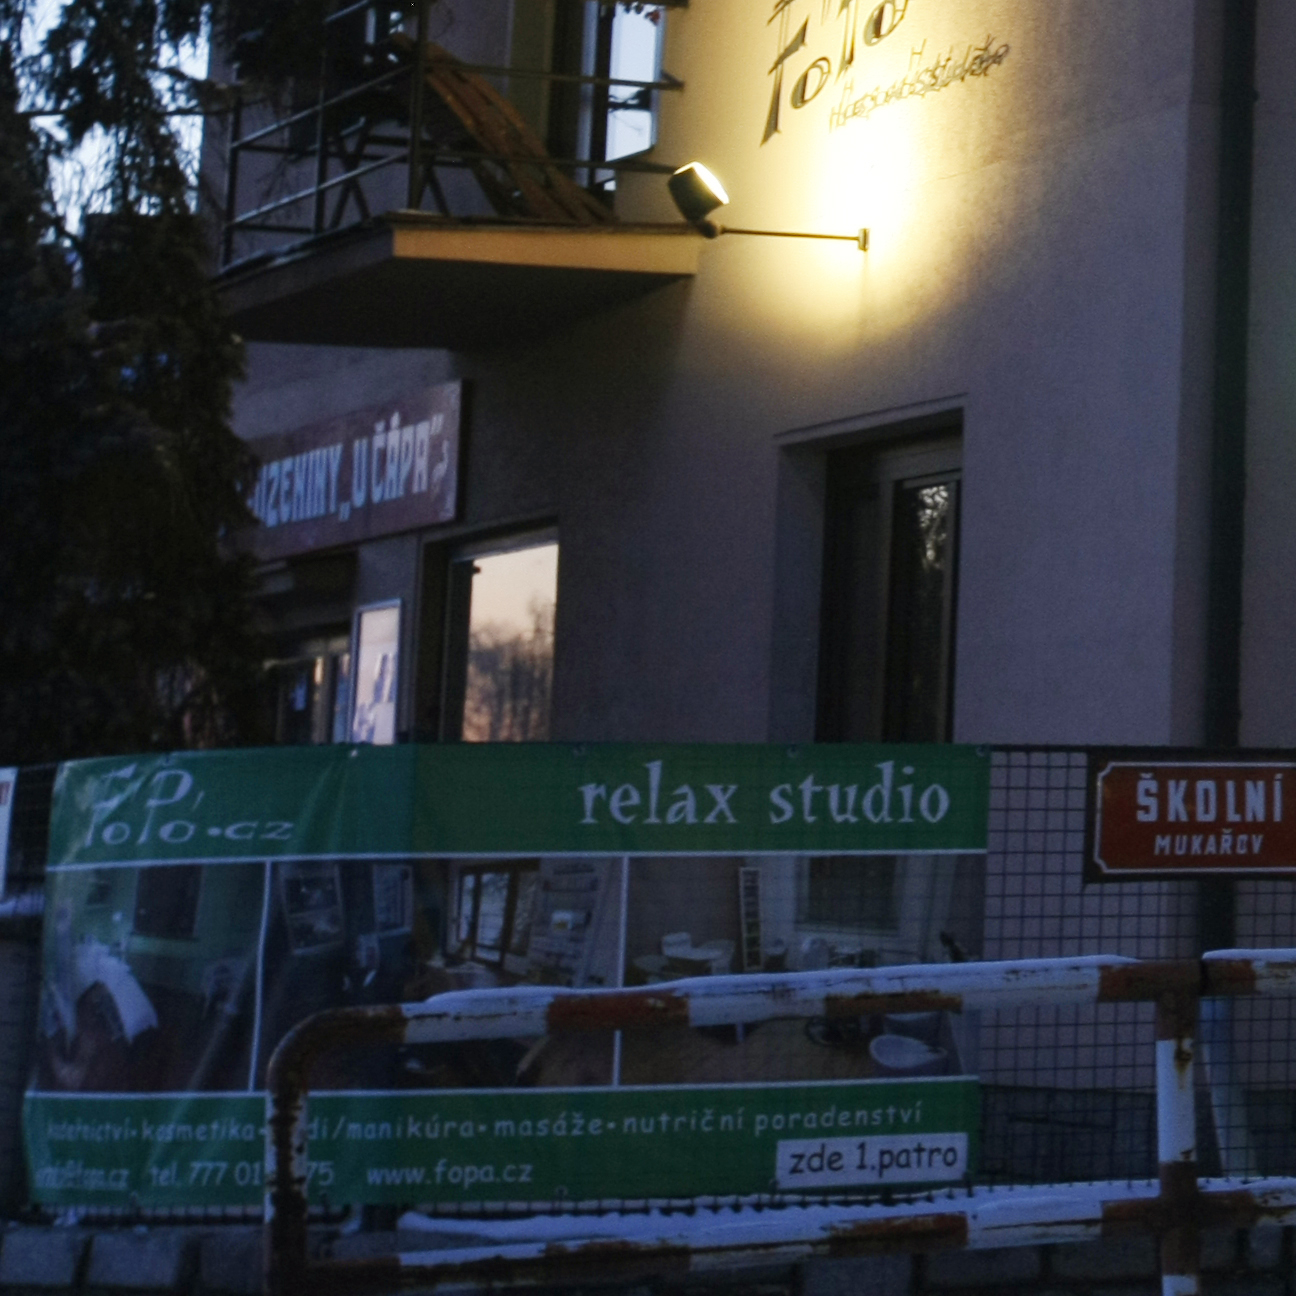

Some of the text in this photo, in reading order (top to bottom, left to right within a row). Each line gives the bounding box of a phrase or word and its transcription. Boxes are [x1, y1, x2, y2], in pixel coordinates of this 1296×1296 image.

[578, 760, 951, 825] relax studio
[1136, 772, 1283, 822] ŠKOLNÍ
[1154, 828, 1264, 855] MUKAŘOV
[755, 1100, 923, 1137] poradenství
[188, 1161, 229, 1187] 777
[366, 1158, 534, 1188] www.fopa.cz
[789, 1144, 844, 1175] zde
